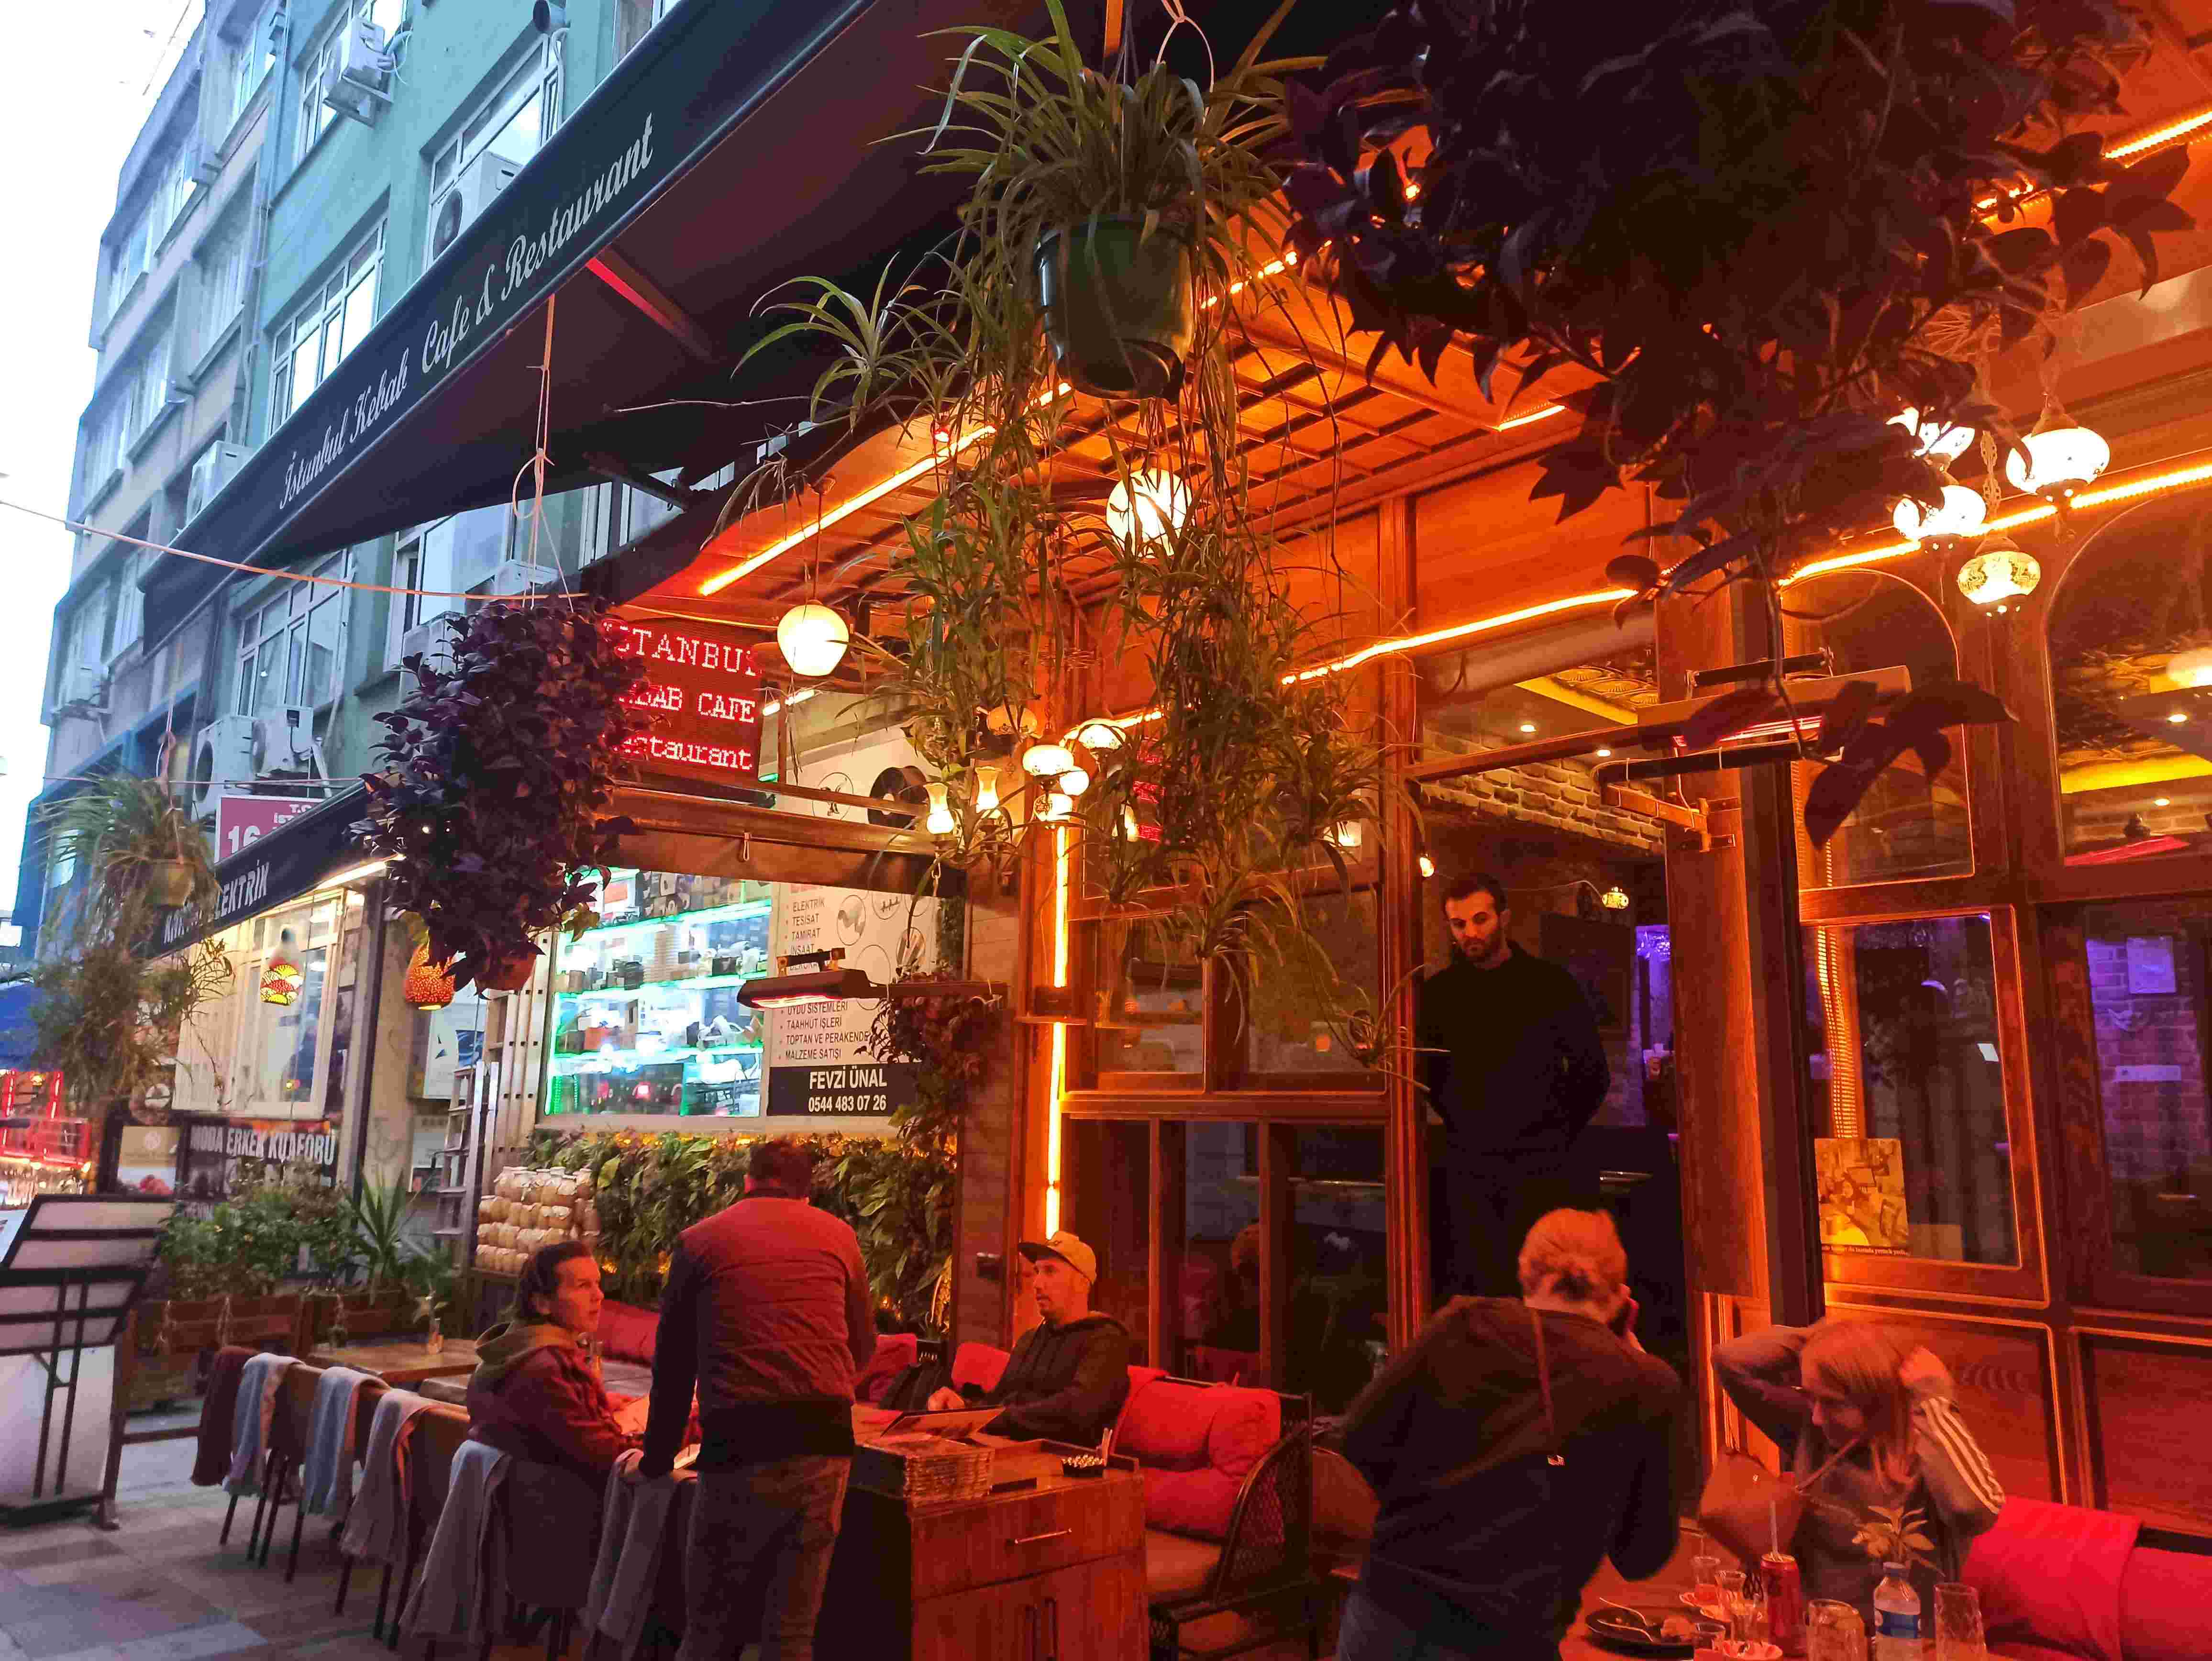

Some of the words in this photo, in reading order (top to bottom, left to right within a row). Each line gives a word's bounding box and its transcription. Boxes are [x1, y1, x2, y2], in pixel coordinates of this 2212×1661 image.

[351, 348, 409, 442] Kebab
[421, 295, 469, 375] Cafe
[502, 112, 654, 301] Restaurant
[698, 692, 756, 723] CAFE
[786, 1034, 813, 1046] TOPTAN
[814, 1033, 823, 1044] VE
[785, 1049, 818, 1061] MALZEME
[809, 1065, 846, 1090] FEVZİ
[849, 1066, 887, 1088] ÜNAL
[808, 1096, 832, 1112] 0544
[835, 1096, 854, 1111] 483
[857, 1095, 870, 1111] 07
[873, 1095, 886, 1111] 26
